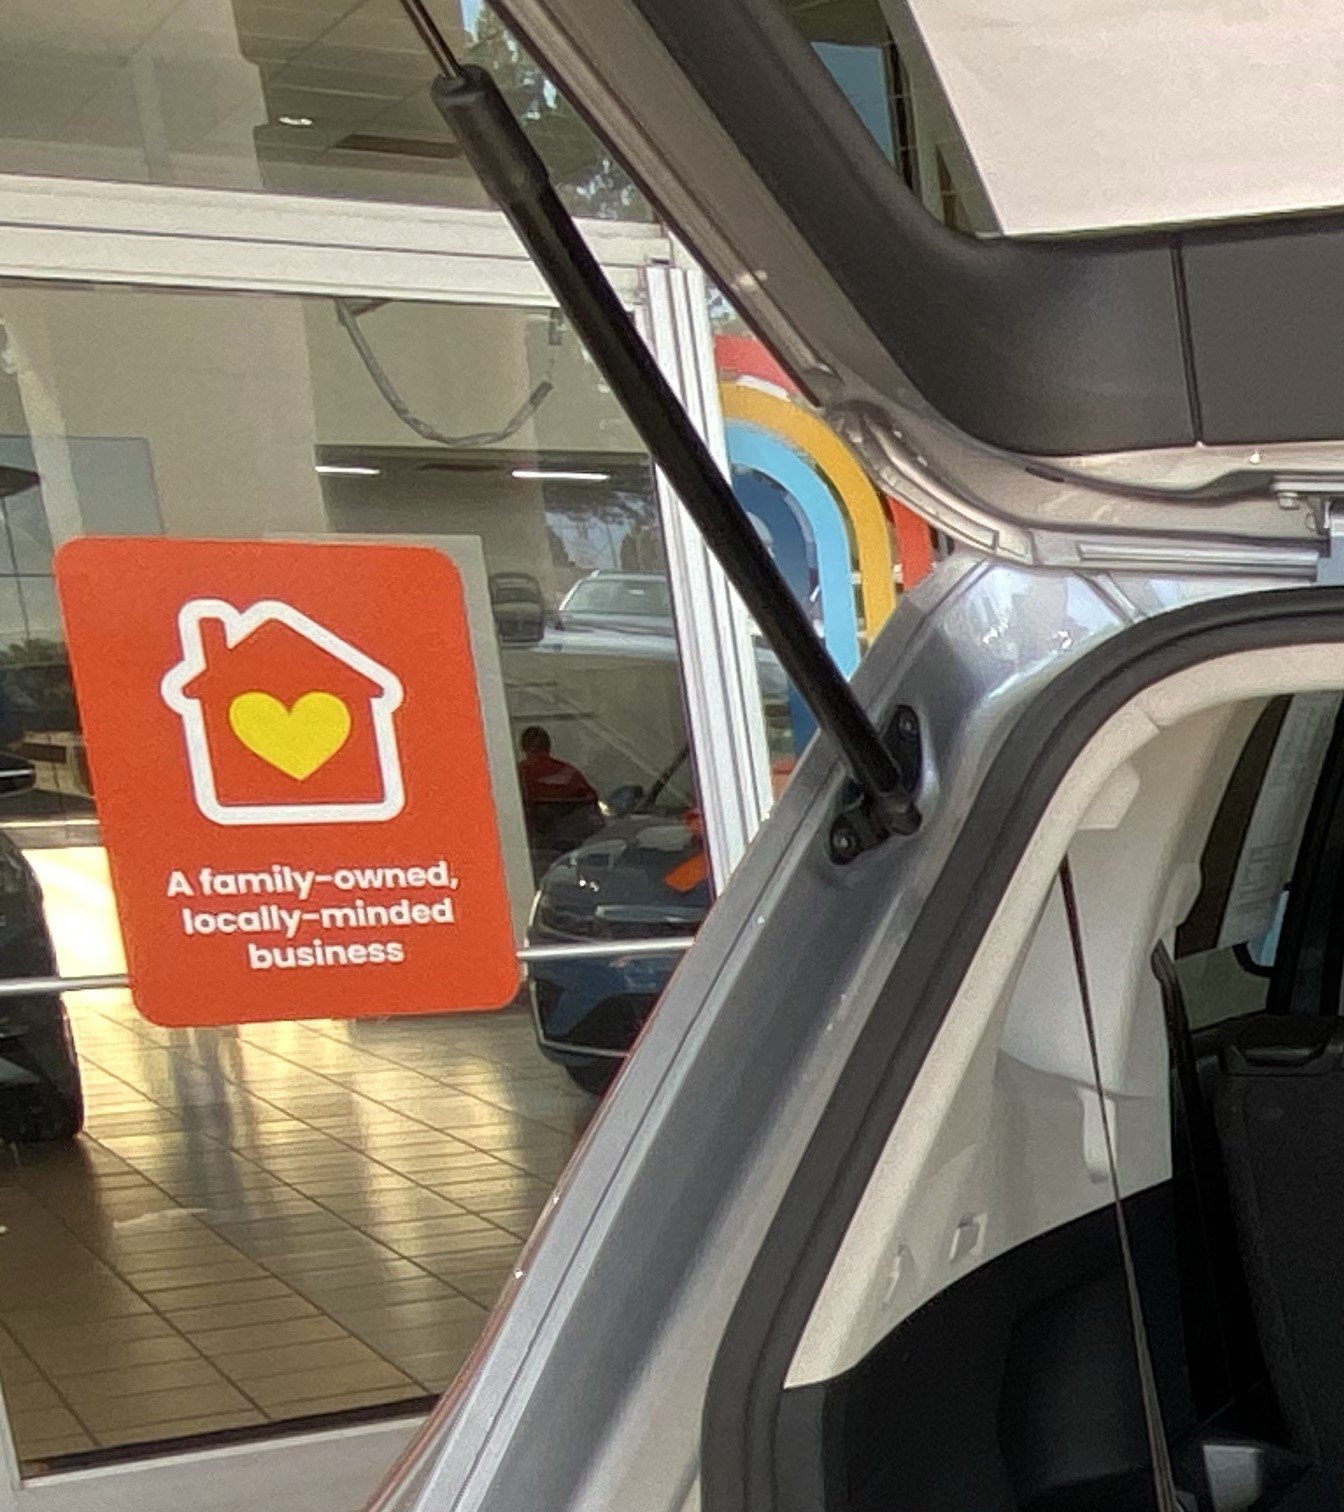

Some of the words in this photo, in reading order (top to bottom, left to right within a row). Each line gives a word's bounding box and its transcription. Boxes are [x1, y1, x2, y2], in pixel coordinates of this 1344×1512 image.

[167, 870, 194, 897] A
[199, 860, 459, 899] family-owned,
[182, 897, 454, 938] locally-minded
[248, 939, 405, 969] business
